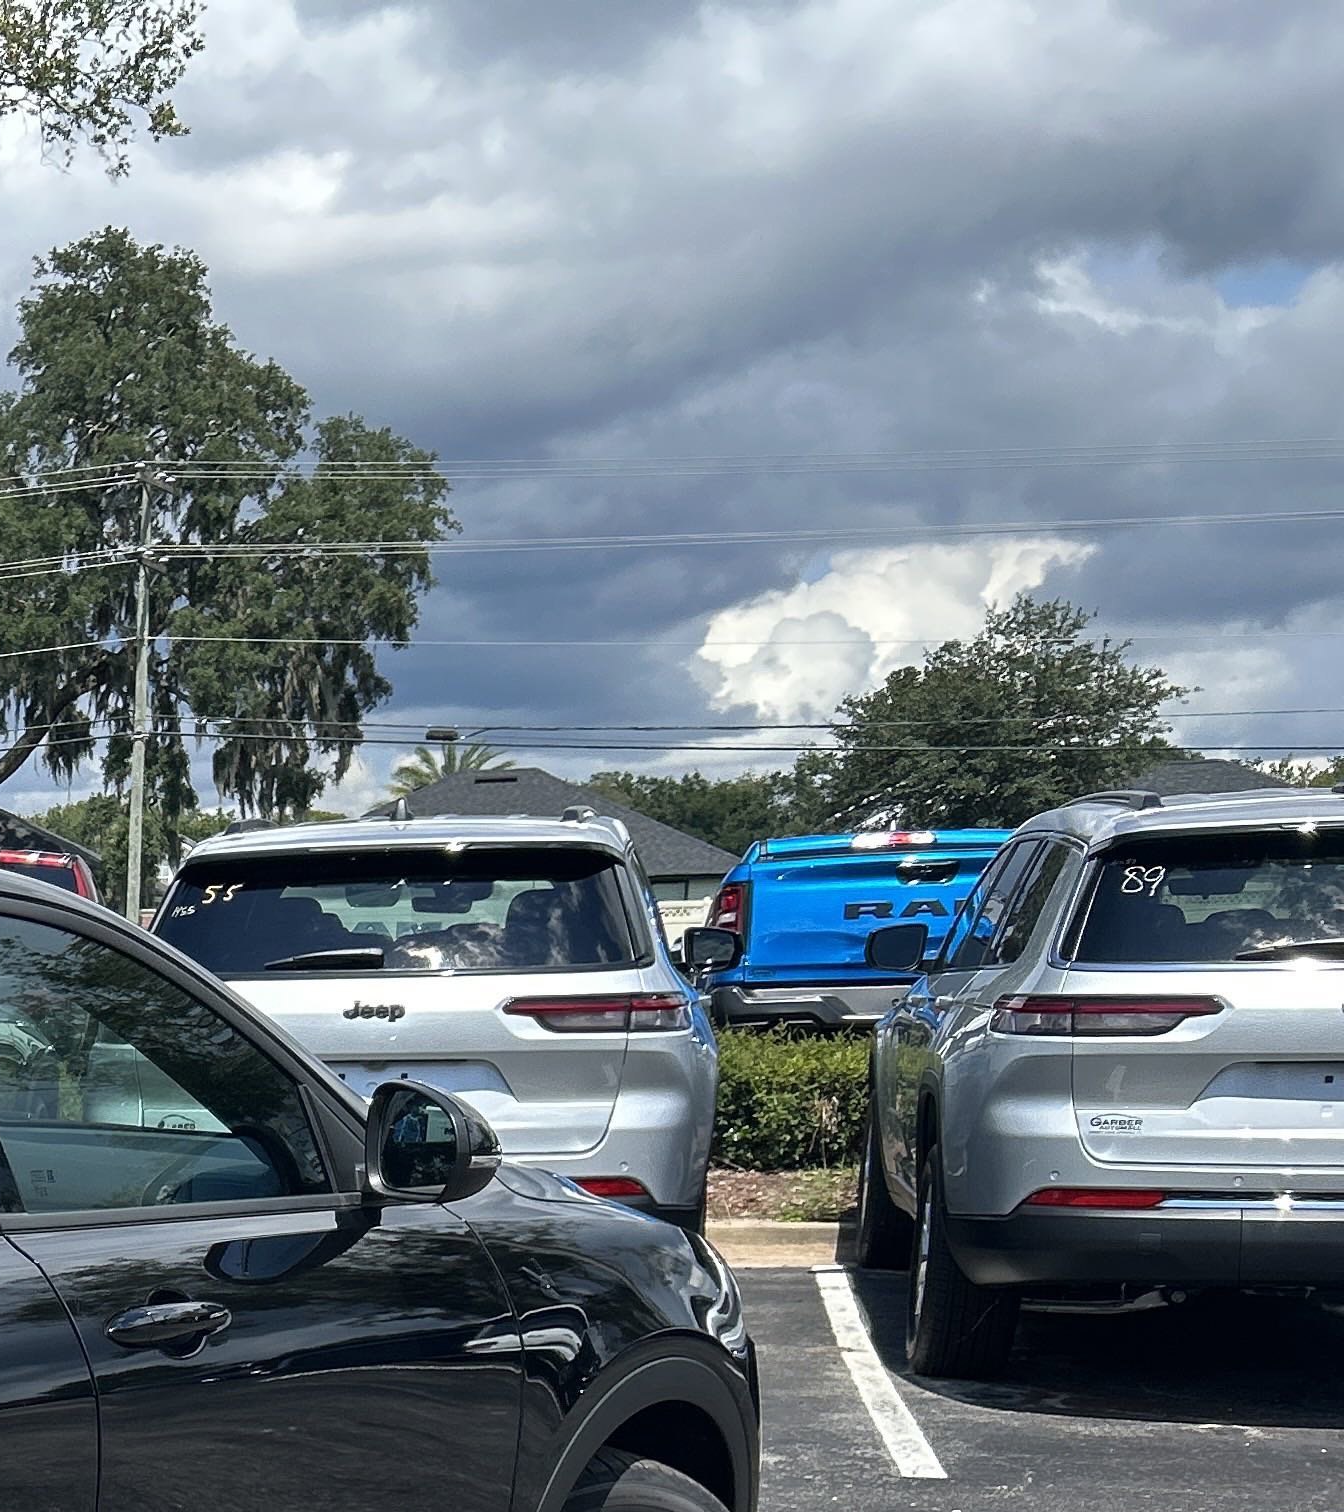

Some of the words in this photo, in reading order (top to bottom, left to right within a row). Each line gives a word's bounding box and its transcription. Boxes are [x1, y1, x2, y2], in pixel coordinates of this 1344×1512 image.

[1122, 866, 1165, 896] 89
[202, 883, 244, 904] 55
[343, 1001, 405, 1022] Jeep
